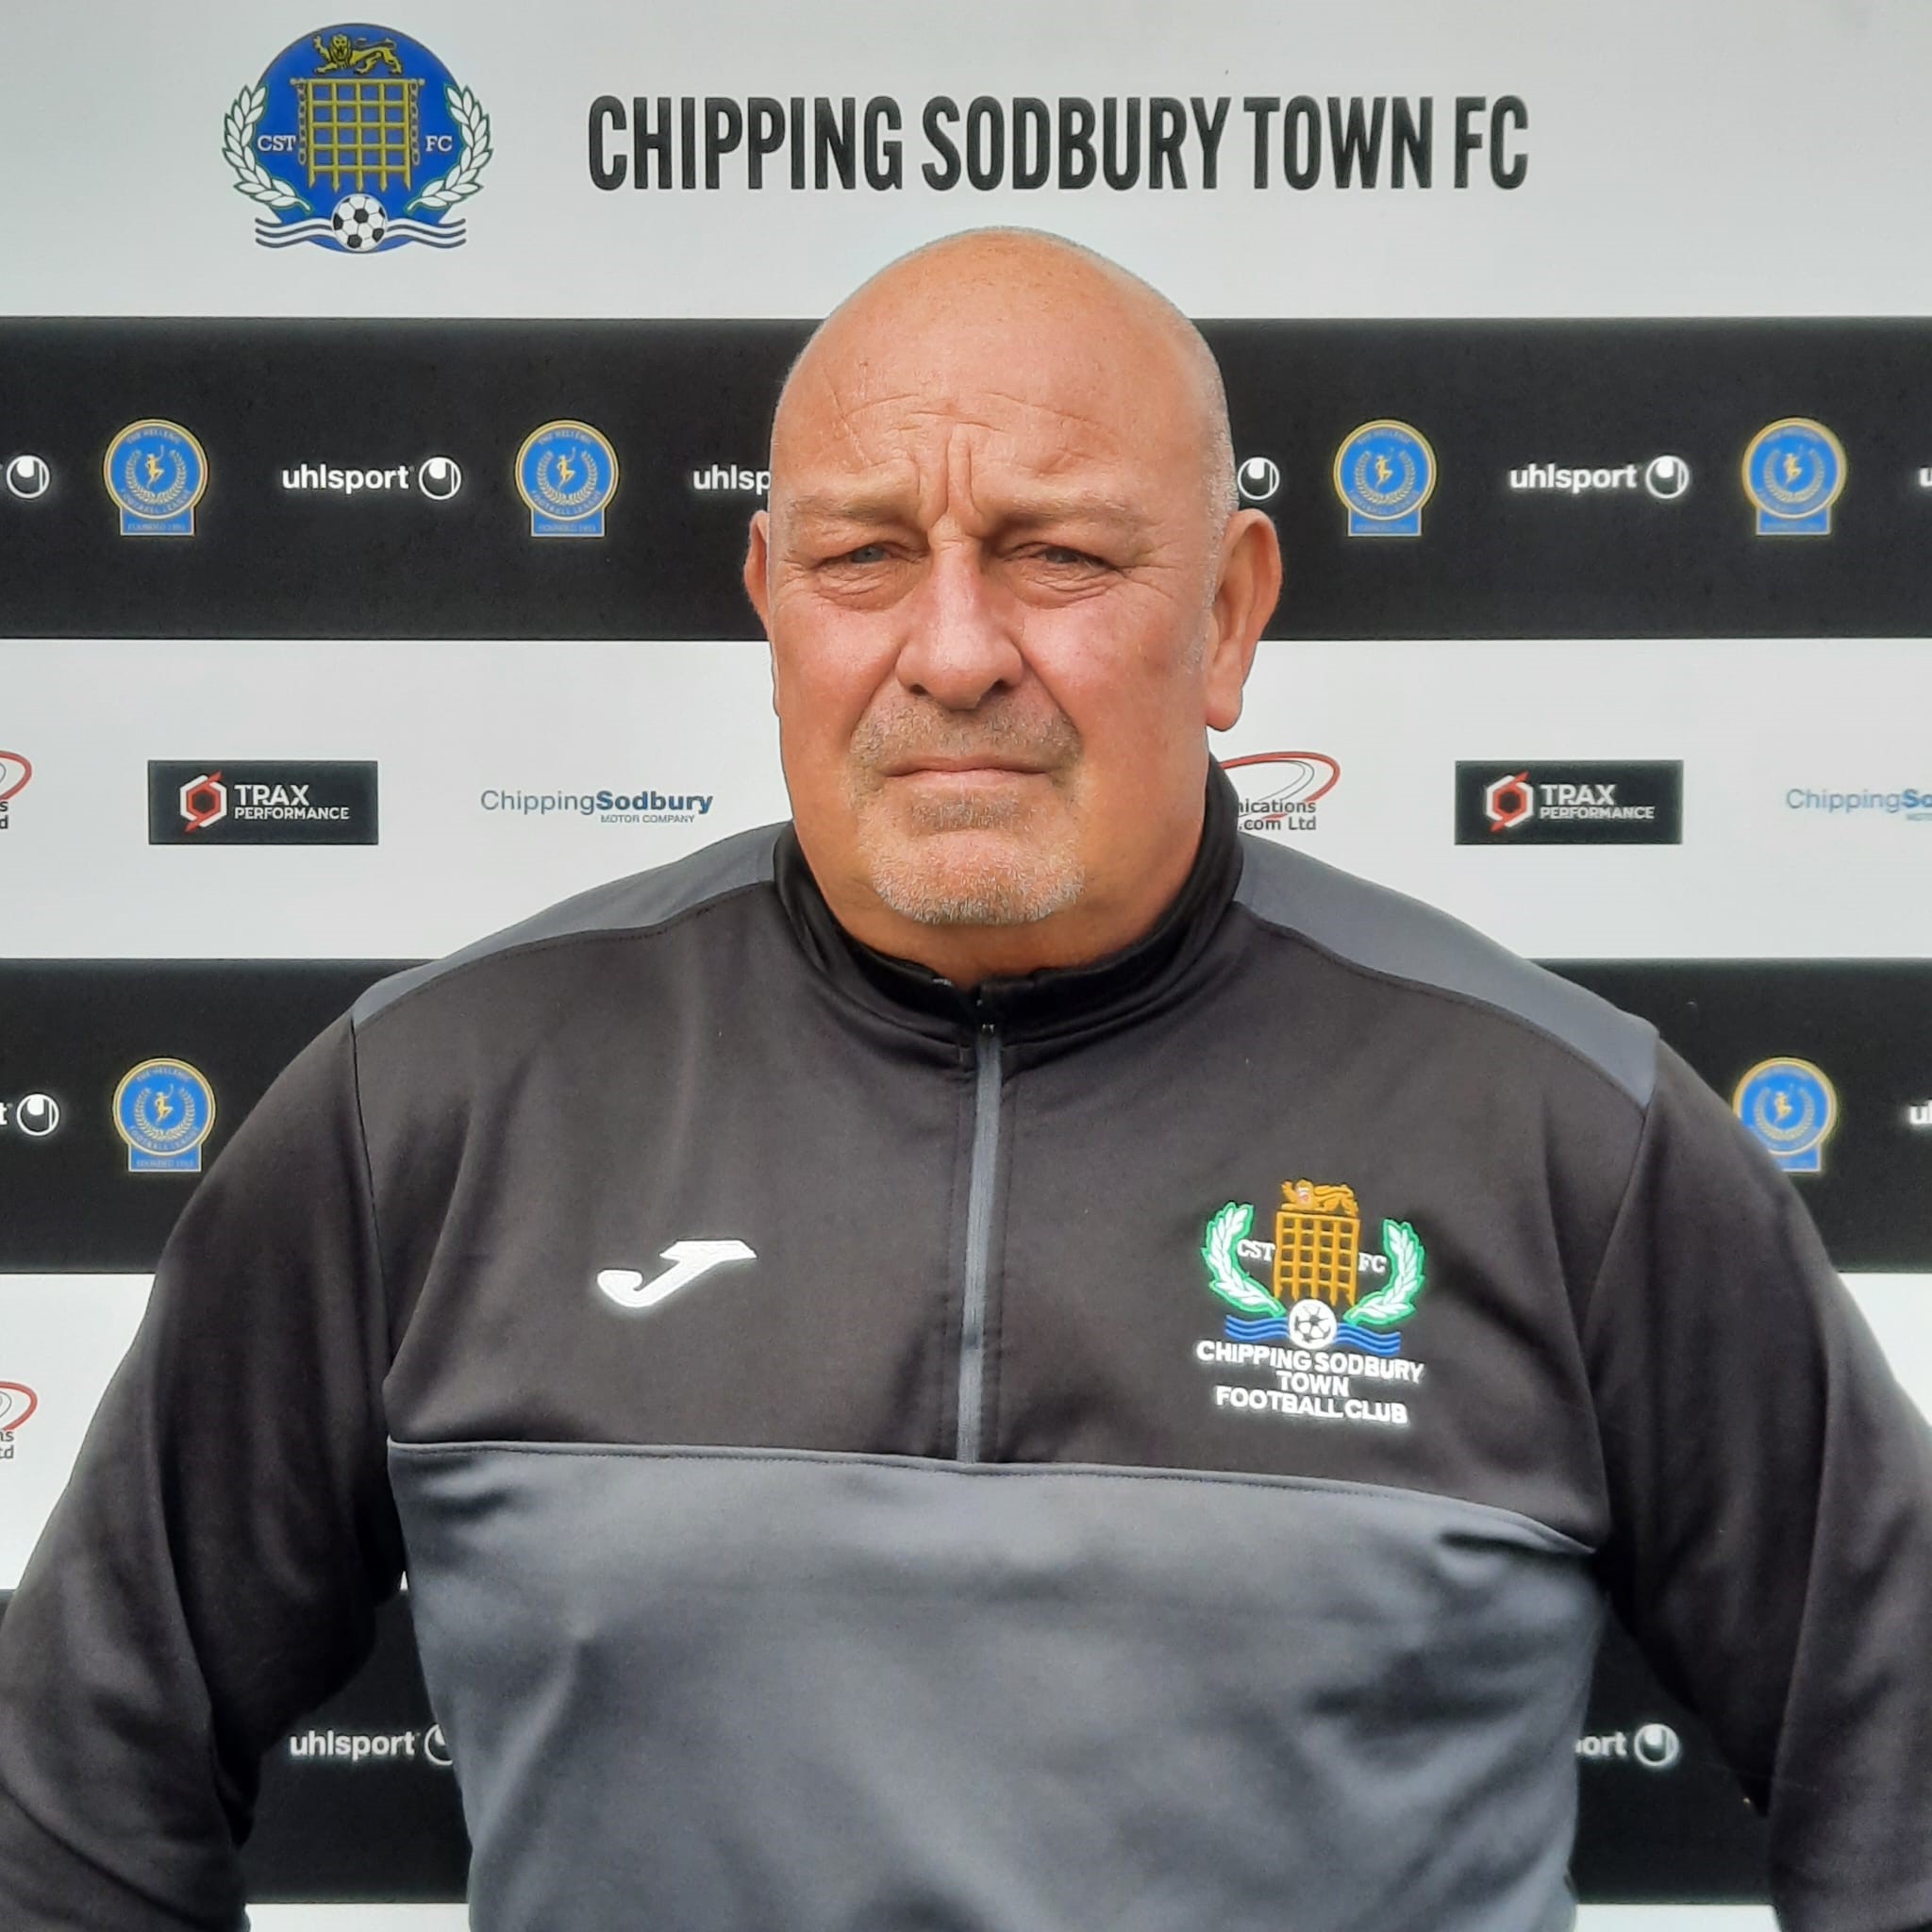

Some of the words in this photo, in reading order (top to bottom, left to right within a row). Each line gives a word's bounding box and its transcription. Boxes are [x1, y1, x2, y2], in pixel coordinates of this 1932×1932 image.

[258, 135, 297, 153] CST
[425, 135, 453, 153] FC
[588, 95, 902, 192] CHIPPING
[922, 95, 1231, 192] SODBURY
[1243, 95, 1433, 192] TOWN
[1454, 95, 1529, 192] FC
[282, 463, 409, 495] uhlsport
[1509, 462, 1638, 494] uhlsport
[234, 785, 310, 807] TRAX
[480, 790, 713, 815] ChippingSodbury
[1540, 784, 1616, 806] TRAX
[234, 807, 350, 820] PERFORMANCE
[600, 814, 640, 824] MOTOR
[642, 814, 695, 824] COMPANY
[1289, 816, 1317, 831] Ltd
[1540, 807, 1656, 820] PERFORMANCE
[1237, 1240, 1275, 1261] CST
[1357, 1253, 1387, 1273] FC
[1196, 1341, 1312, 1371] CHIPPING
[1314, 1357, 1424, 1384] SODBURY
[1275, 1370, 1351, 1397] TOWN
[1215, 1385, 1344, 1419] FOOTBALL
[1344, 1399, 1408, 1424] CLUB
[290, 1729, 416, 1762] uhlsport
